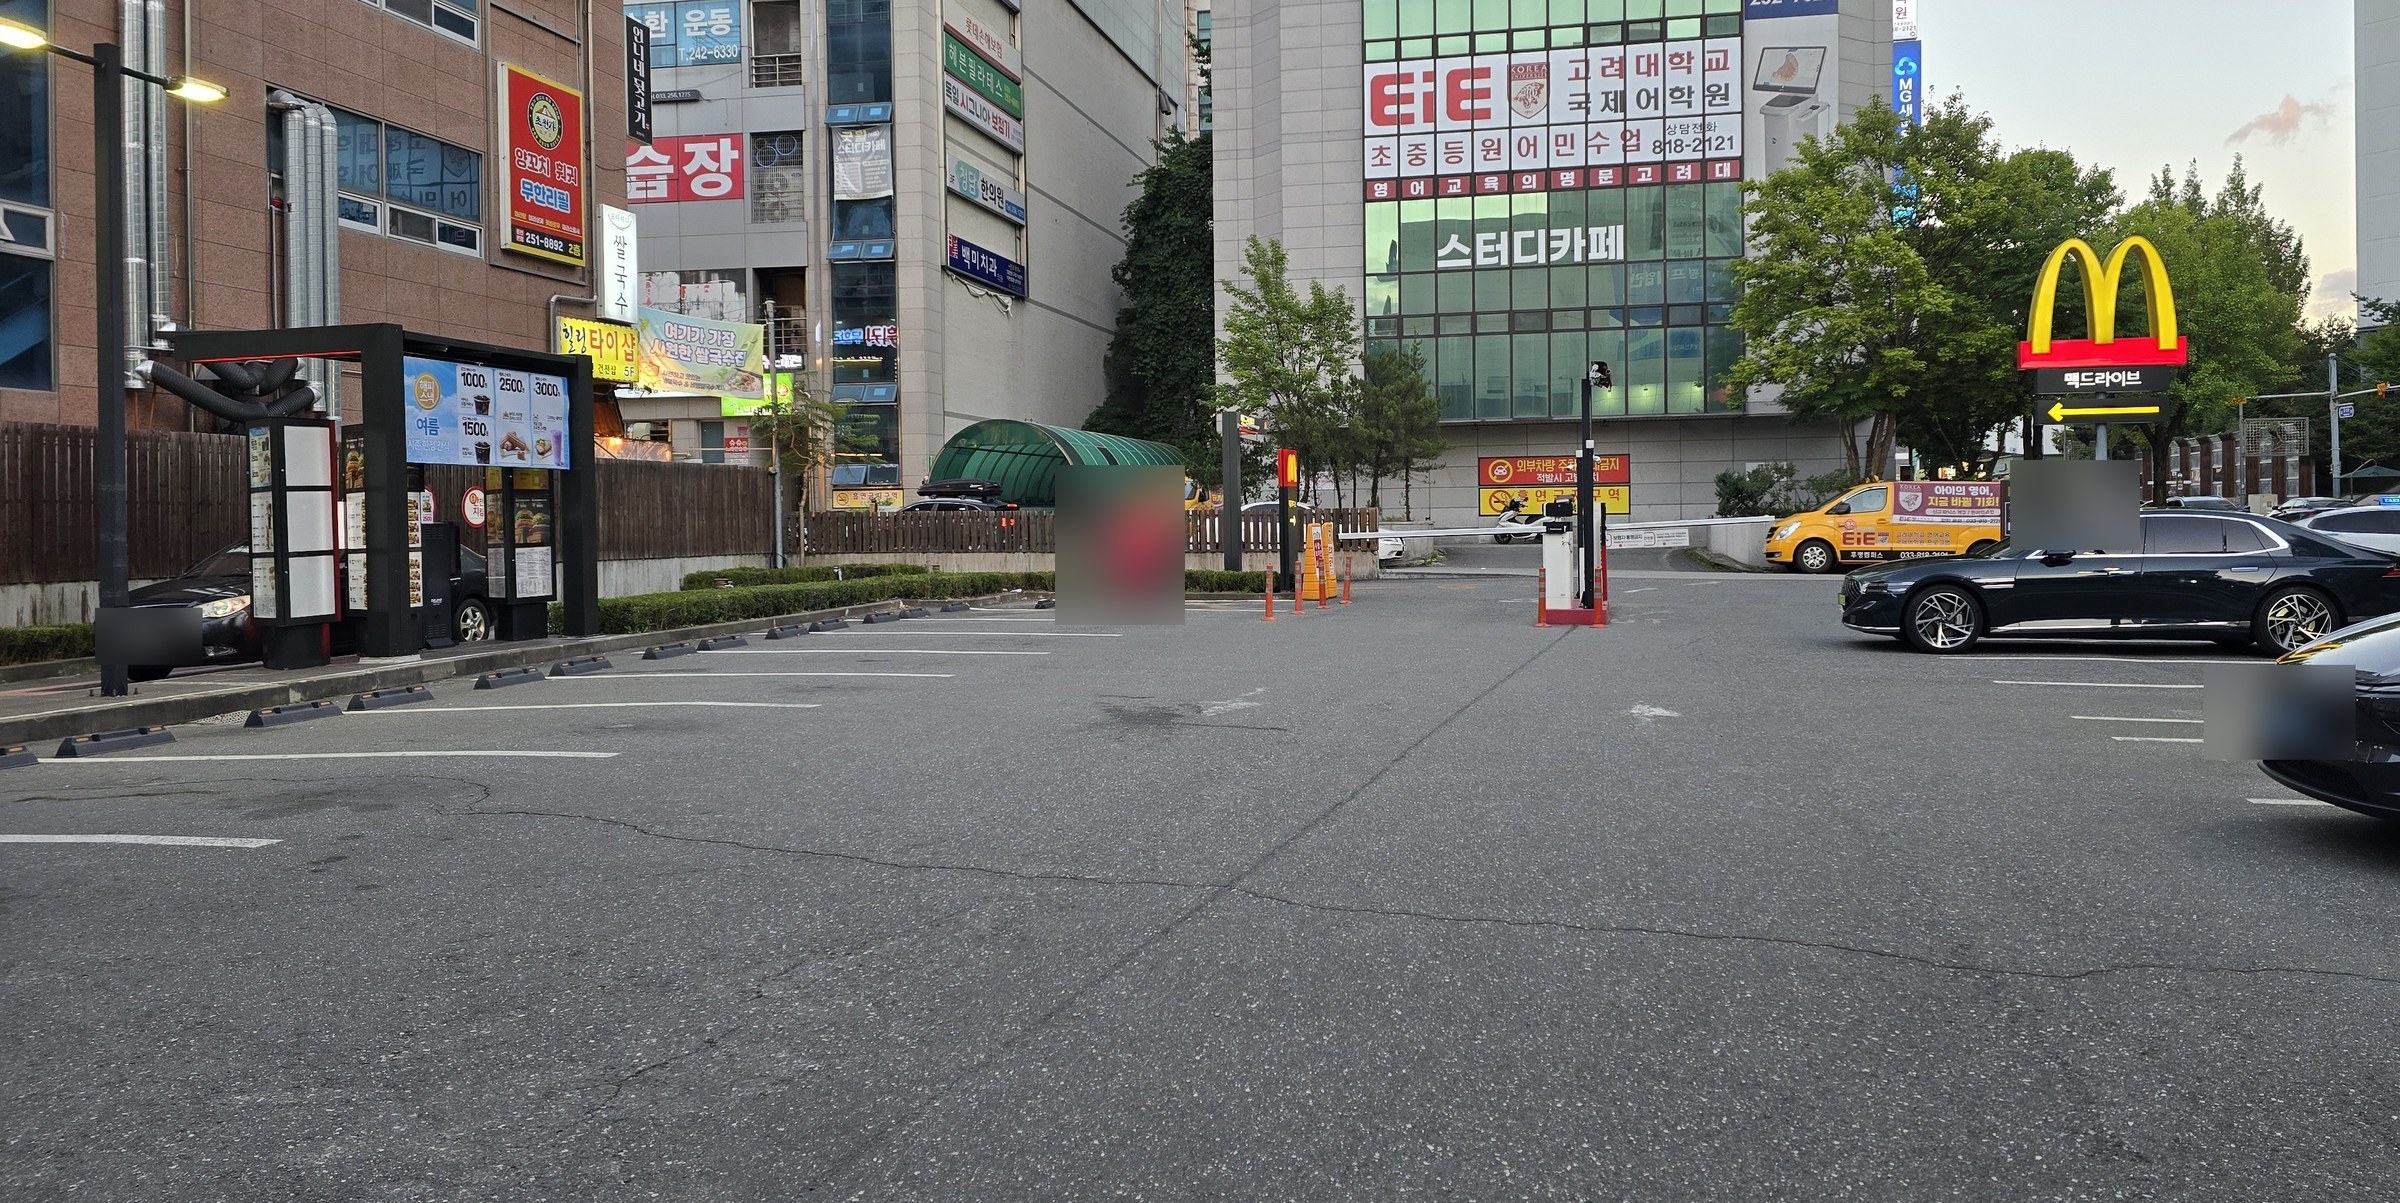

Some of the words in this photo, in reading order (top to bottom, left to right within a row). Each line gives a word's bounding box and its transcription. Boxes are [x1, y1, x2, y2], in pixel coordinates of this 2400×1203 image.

[628, 10, 669, 38] 환
[683, 8, 733, 36] 운동
[965, 17, 1003, 59] 롯데손해보험
[679, 44, 738, 61] T.242-6330
[1568, 49, 1730, 81] 고려대학교
[948, 42, 1003, 98] 헤븐필라테스
[945, 80, 959, 107] 독일
[960, 92, 991, 126] 시그니아
[991, 111, 1010, 140] 보청기
[1370, 67, 1491, 126] EiE
[1568, 82, 1730, 115] 국제어학원
[1666, 120, 1718, 135] 상담전화
[837, 139, 886, 154] 스터디카페
[1652, 135, 1735, 155] 818-2121
[514, 147, 551, 178] 양꼬치
[520, 178, 571, 213] 무한리필
[960, 166, 978, 196] 청담
[980, 177, 1004, 211] 한의원
[525, 231, 564, 252] 251-8892
[568, 243, 581, 257] 2층
[1437, 224, 1624, 268] 스터디카페
[961, 244, 998, 278] 백미치과
[614, 235, 628, 316] 쌀국수
[562, 323, 587, 354] 힐링
[663, 321, 705, 344] 여기가
[707, 328, 736, 348] 가장
[650, 338, 693, 362] 시원한
[694, 347, 747, 368] 쌀국수집
[624, 366, 635, 377] 5F
[2063, 371, 2143, 389] 맥드라이브
[419, 380, 435, 392] 해피
[419, 391, 435, 404] 스낵
[416, 417, 440, 436] 여름
[1517, 459, 1555, 472] 외부차량
[1558, 458, 1619, 472] 주차금지
[1536, 473, 1562, 483] 적발시
[1565, 472, 1599, 483] 고발치
[1927, 496, 1949, 507] 지금
[1975, 496, 1999, 507] 기회!
[1934, 485, 1966, 496] 아이의
[1968, 485, 1994, 497] 영어,
[1842, 531, 1876, 546] EiE
